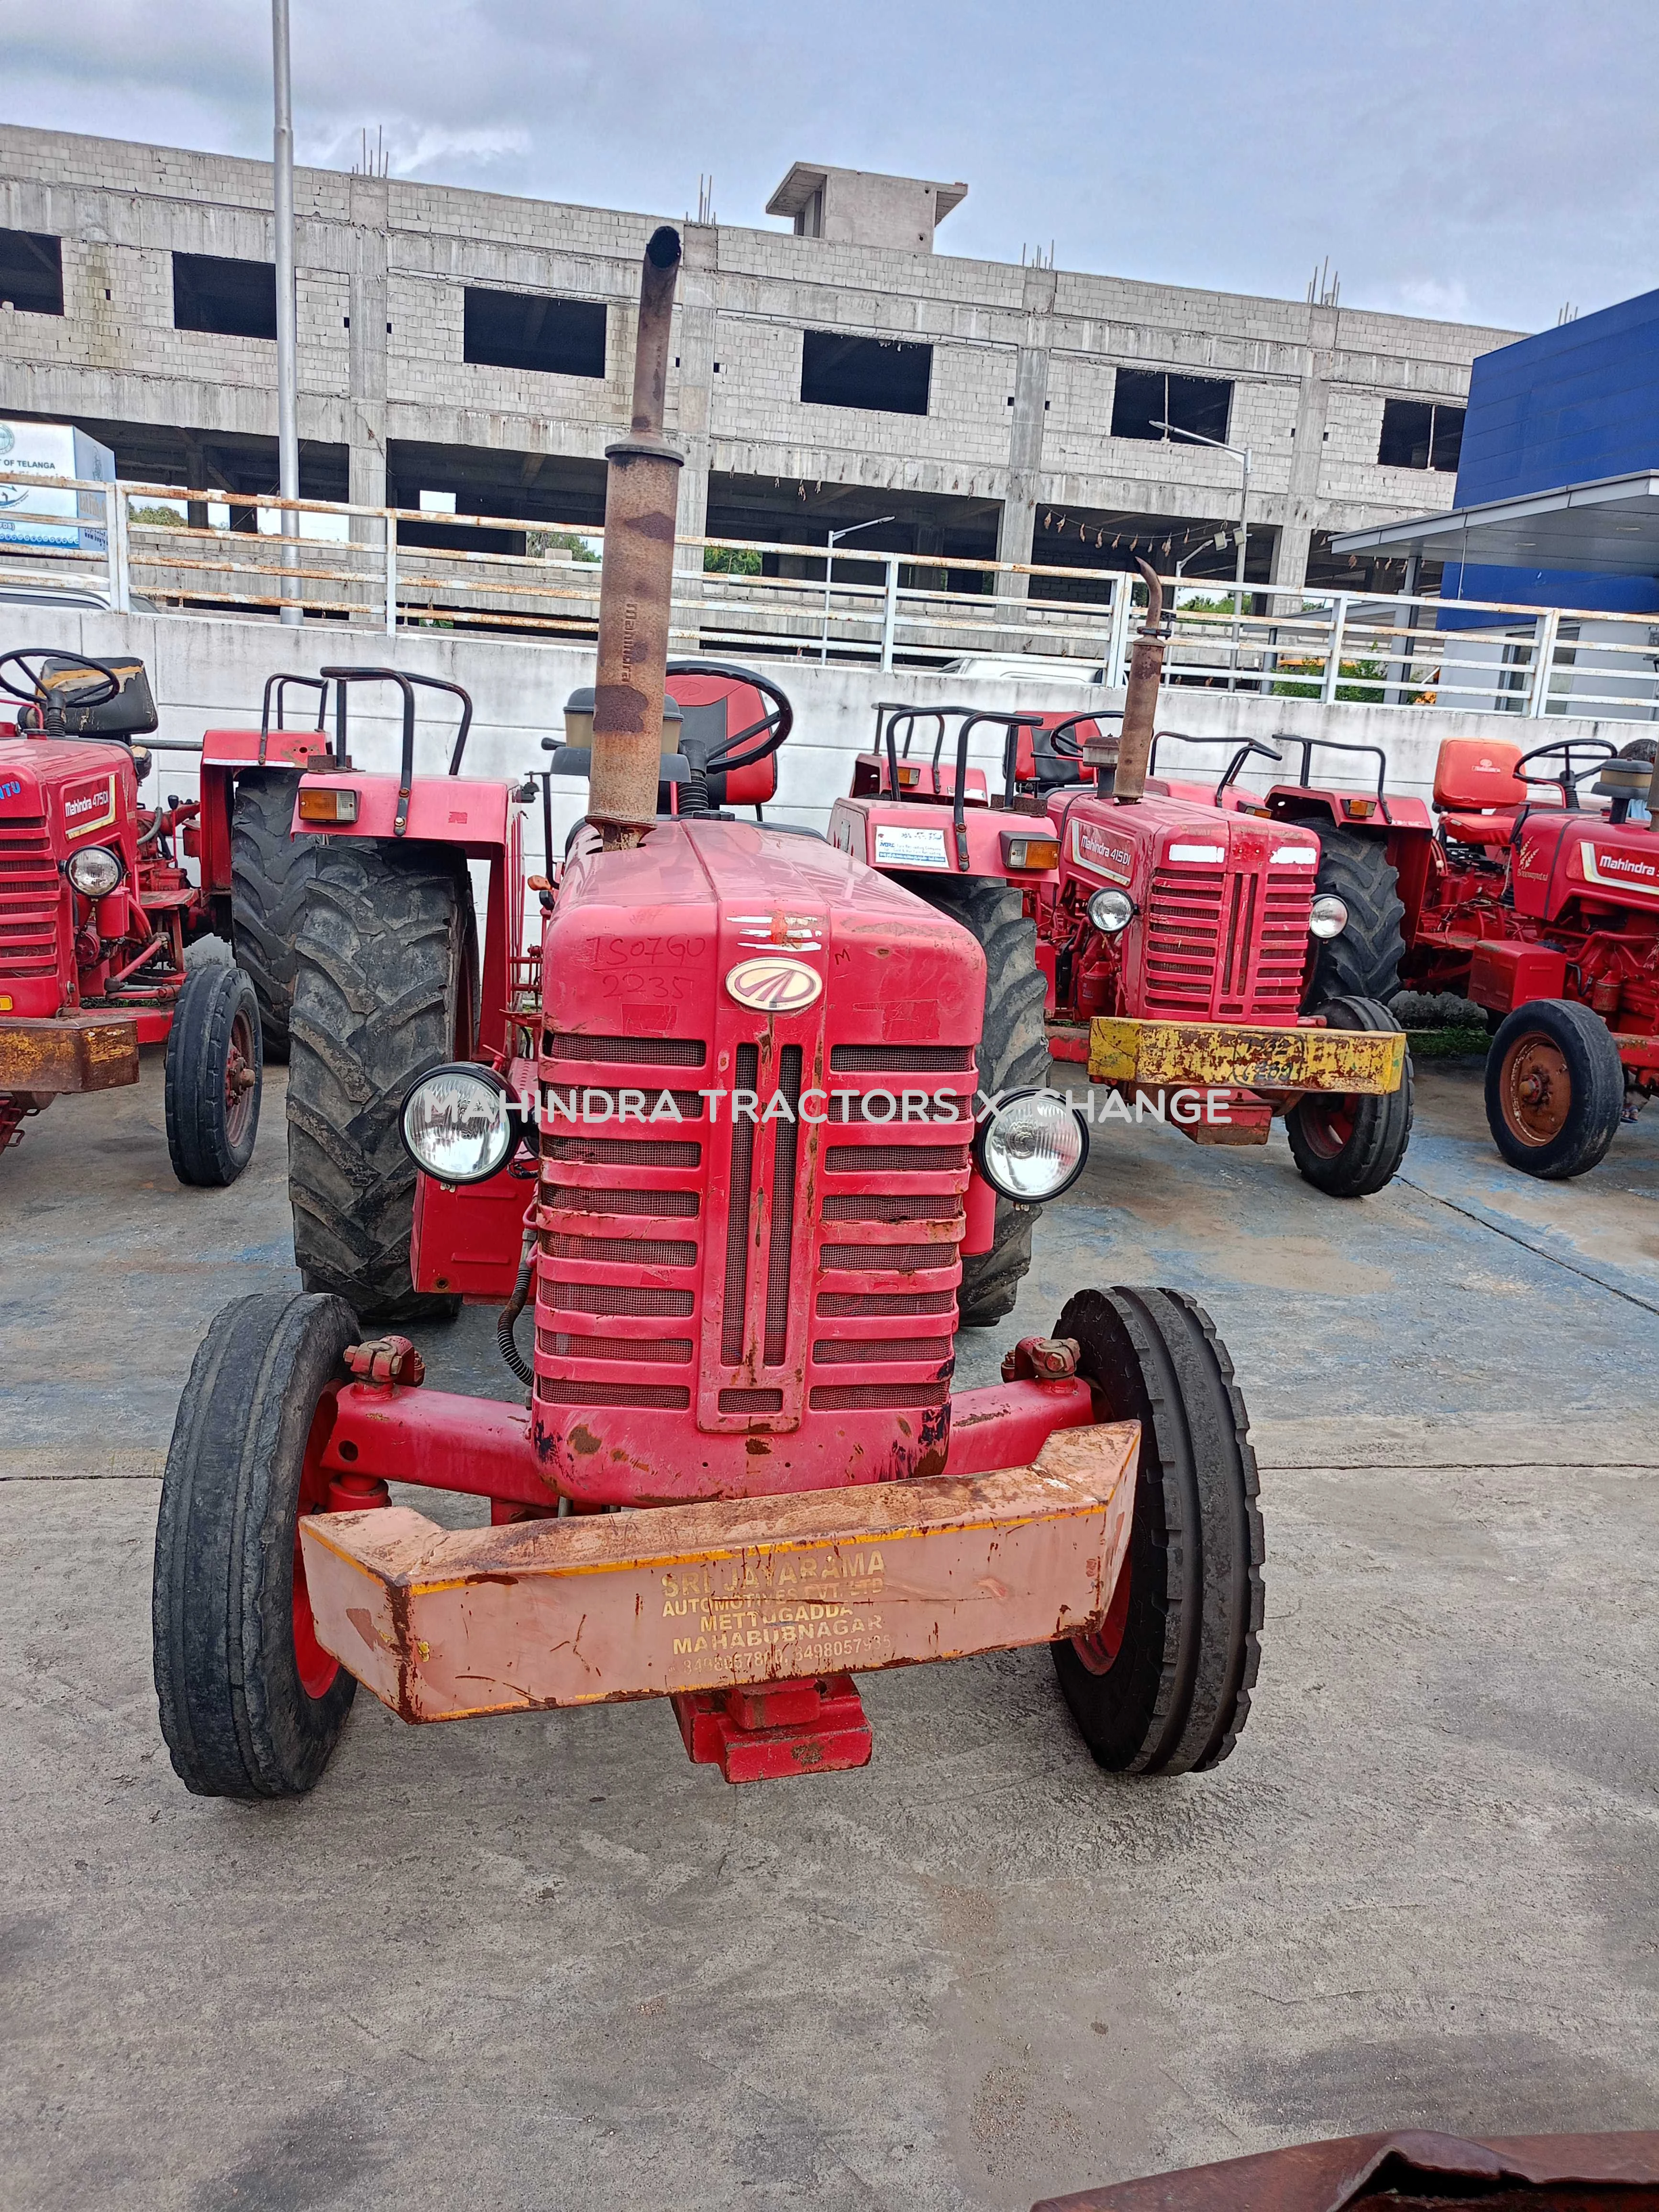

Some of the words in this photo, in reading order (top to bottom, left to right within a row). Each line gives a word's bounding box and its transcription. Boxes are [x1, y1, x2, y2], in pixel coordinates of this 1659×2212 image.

[17, 460, 55, 469] TELANGA
[621, 603, 637, 683] Mahindra
[65, 796, 92, 818] Mahindra
[92, 790, 109, 807] 475DI
[1081, 834, 1110, 858] Mahindra
[1110, 849, 1131, 866] 415DI
[1599, 855, 1656, 876] Mahindra
[602, 974, 695, 999] 2235
[662, 1567, 711, 1598] SRI
[723, 1549, 886, 1592] JAYARAMA
[662, 1588, 798, 1617] AUTOMOTIVES
[700, 1604, 854, 1633] METTUGADDA
[673, 1615, 884, 1655] MAHABUBNAGAR
